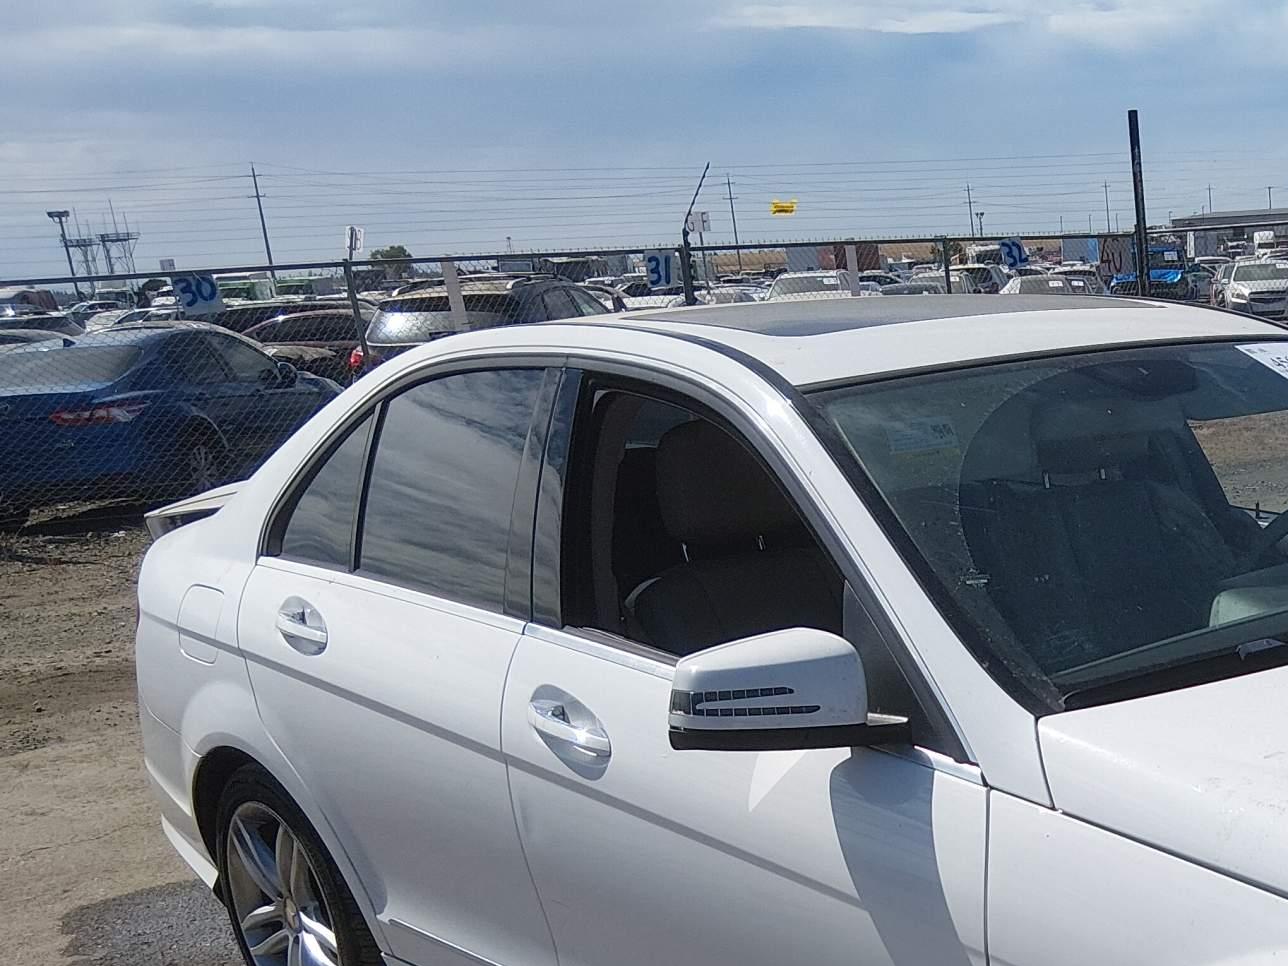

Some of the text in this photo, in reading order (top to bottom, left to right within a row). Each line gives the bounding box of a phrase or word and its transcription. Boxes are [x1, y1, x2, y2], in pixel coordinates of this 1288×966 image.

[1001, 240, 1029, 268] 32
[647, 255, 671, 286] 31
[174, 275, 217, 308] 30
